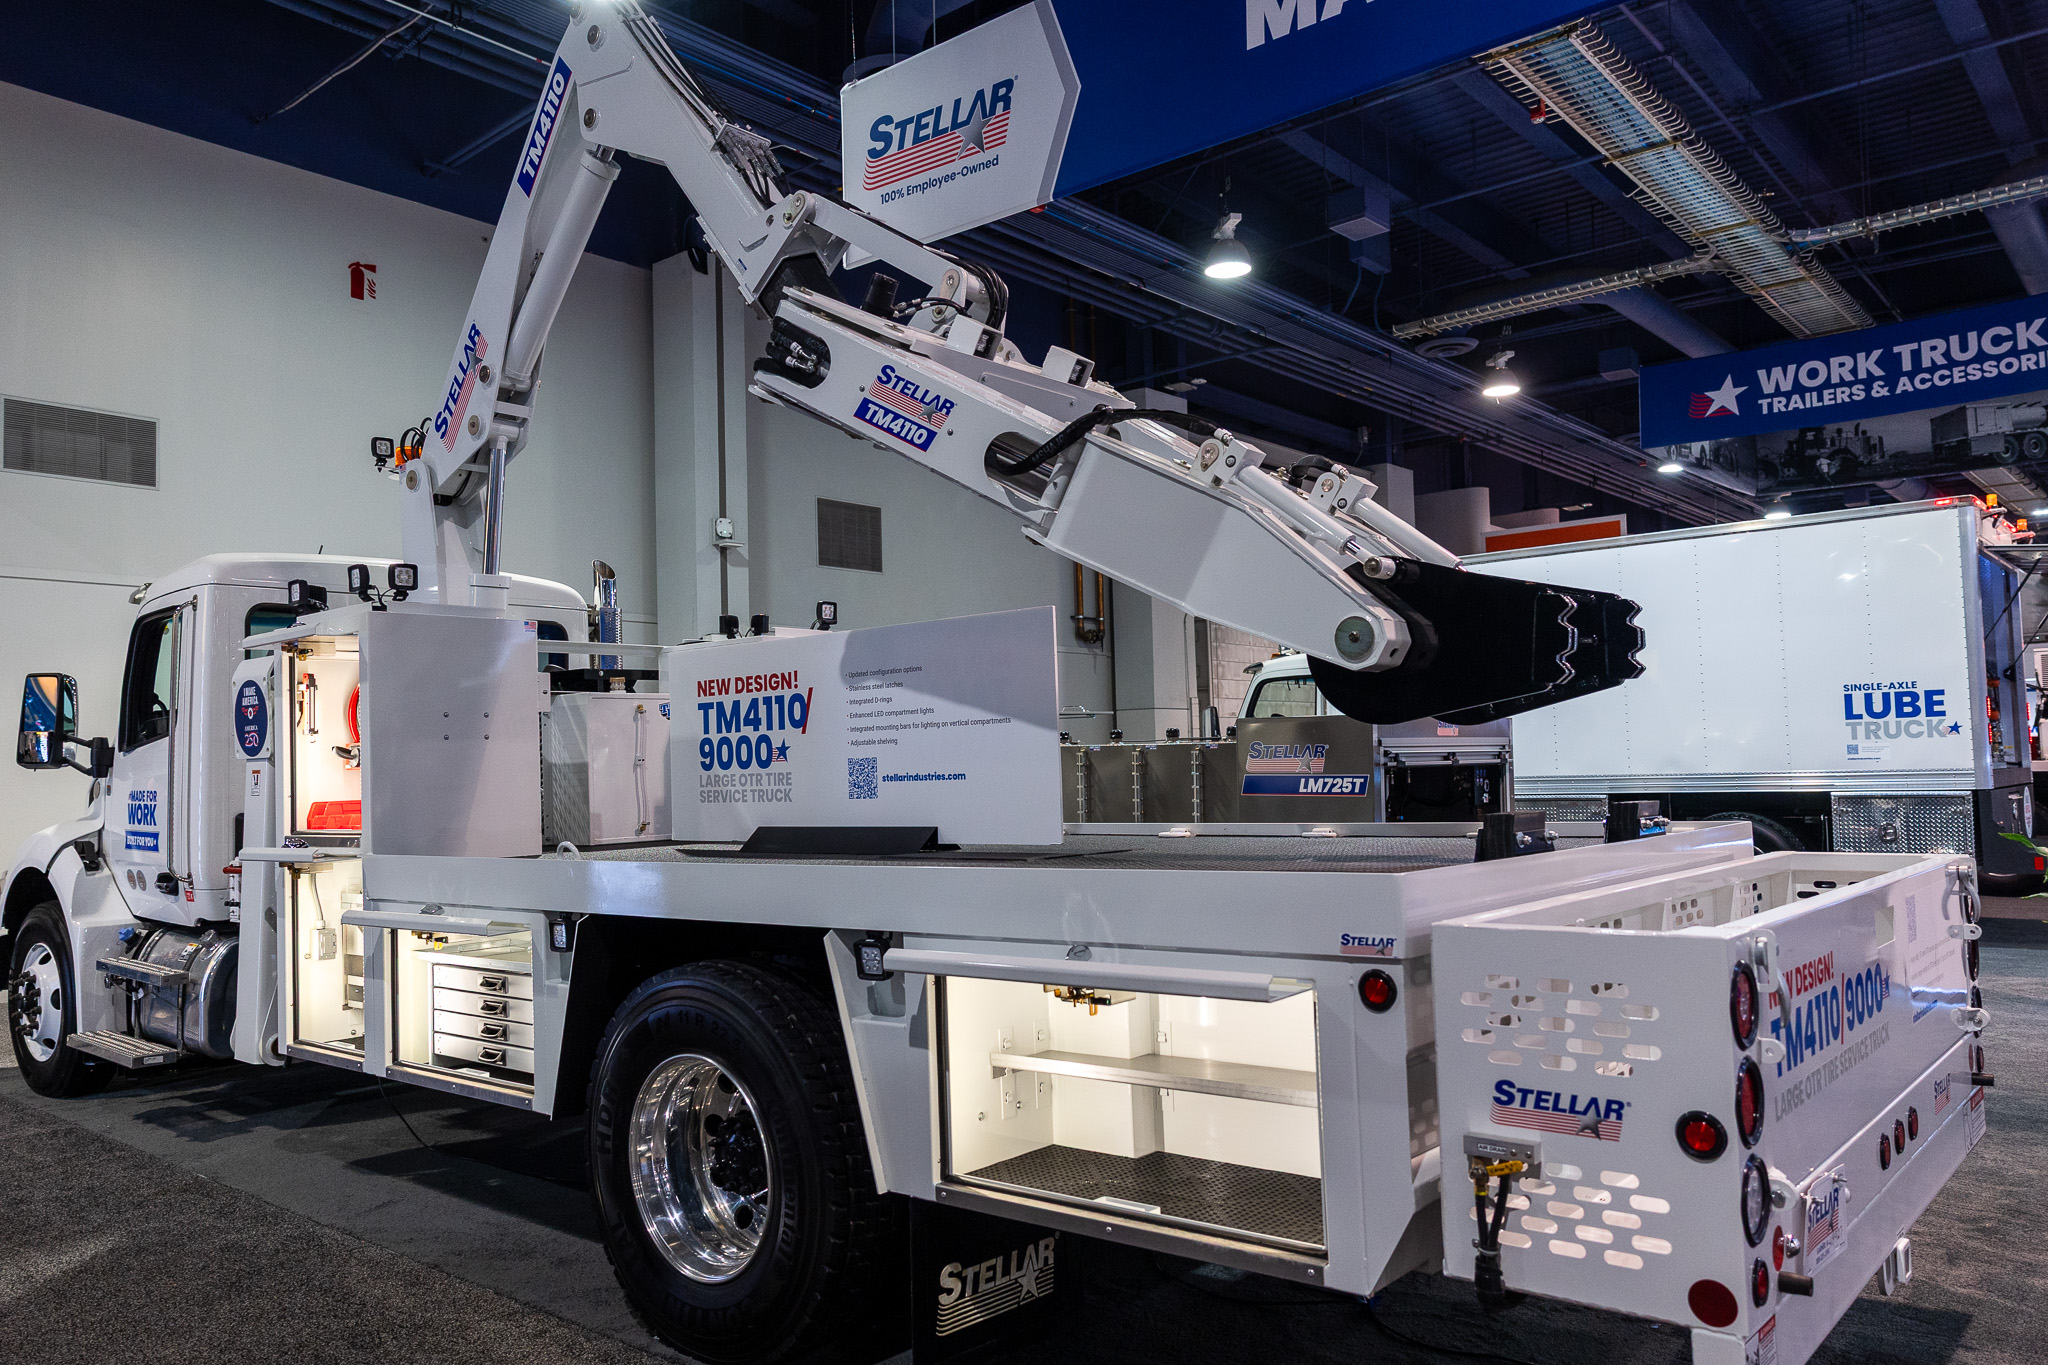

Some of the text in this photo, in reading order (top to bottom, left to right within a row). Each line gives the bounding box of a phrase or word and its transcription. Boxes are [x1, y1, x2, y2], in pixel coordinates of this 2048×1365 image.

[522, 72, 565, 178] TM4110
[867, 78, 1014, 160] STELLAR
[880, 155, 999, 204] 100% Employee-Owned
[434, 322, 481, 440] STELLAR
[1756, 349, 1886, 394] WORK
[1758, 351, 2048, 414] TRAILERS & ACCESSORI
[877, 364, 955, 416] STELLAR
[865, 403, 928, 445] TM4110
[697, 670, 799, 697] NEW DESIGN!
[848, 665, 922, 679] Updated configuration options
[849, 684, 871, 692] Stainless
[885, 681, 903, 689] latches
[1843, 681, 1918, 692] SINGLE-AXLE
[849, 696, 893, 706] Integrated D-rings
[1844, 689, 1947, 720] LUBE
[850, 711, 873, 719] Enhanced
[885, 708, 919, 718] compartment
[919, 707, 935, 715] lights
[850, 725, 875, 733] Integrated
[875, 723, 899, 732] mounting
[900, 722, 911, 730] bars
[921, 720, 941, 730] lighting
[949, 718, 970, 727] vertical
[970, 716, 1012, 727] compartments
[1845, 718, 1947, 740] TRUCK
[699, 734, 773, 772] 9000
[850, 737, 898, 747] Adjustable shelving
[1248, 741, 1326, 759] STELLAR
[699, 772, 792, 788] LARGE OTR TIRE
[881, 772, 966, 782] stellarindustries.com
[1299, 778, 1364, 793] LM725T
[147, 790, 157, 802] FOR
[699, 788, 793, 803] SERVICE TRUCK
[127, 803, 157, 826] WORK
[126, 836, 137, 846] BUILT
[1340, 933, 1395, 948] STELLAR
[1795, 950, 1834, 997] DESIGN!
[1774, 1021, 1890, 1122] LARGE OTR TIRE SERVICE TRUCK
[1492, 1079, 1625, 1121] STELLAR
[1807, 1187, 1839, 1234] STELLAR
[938, 1237, 1055, 1305] STELLAR
